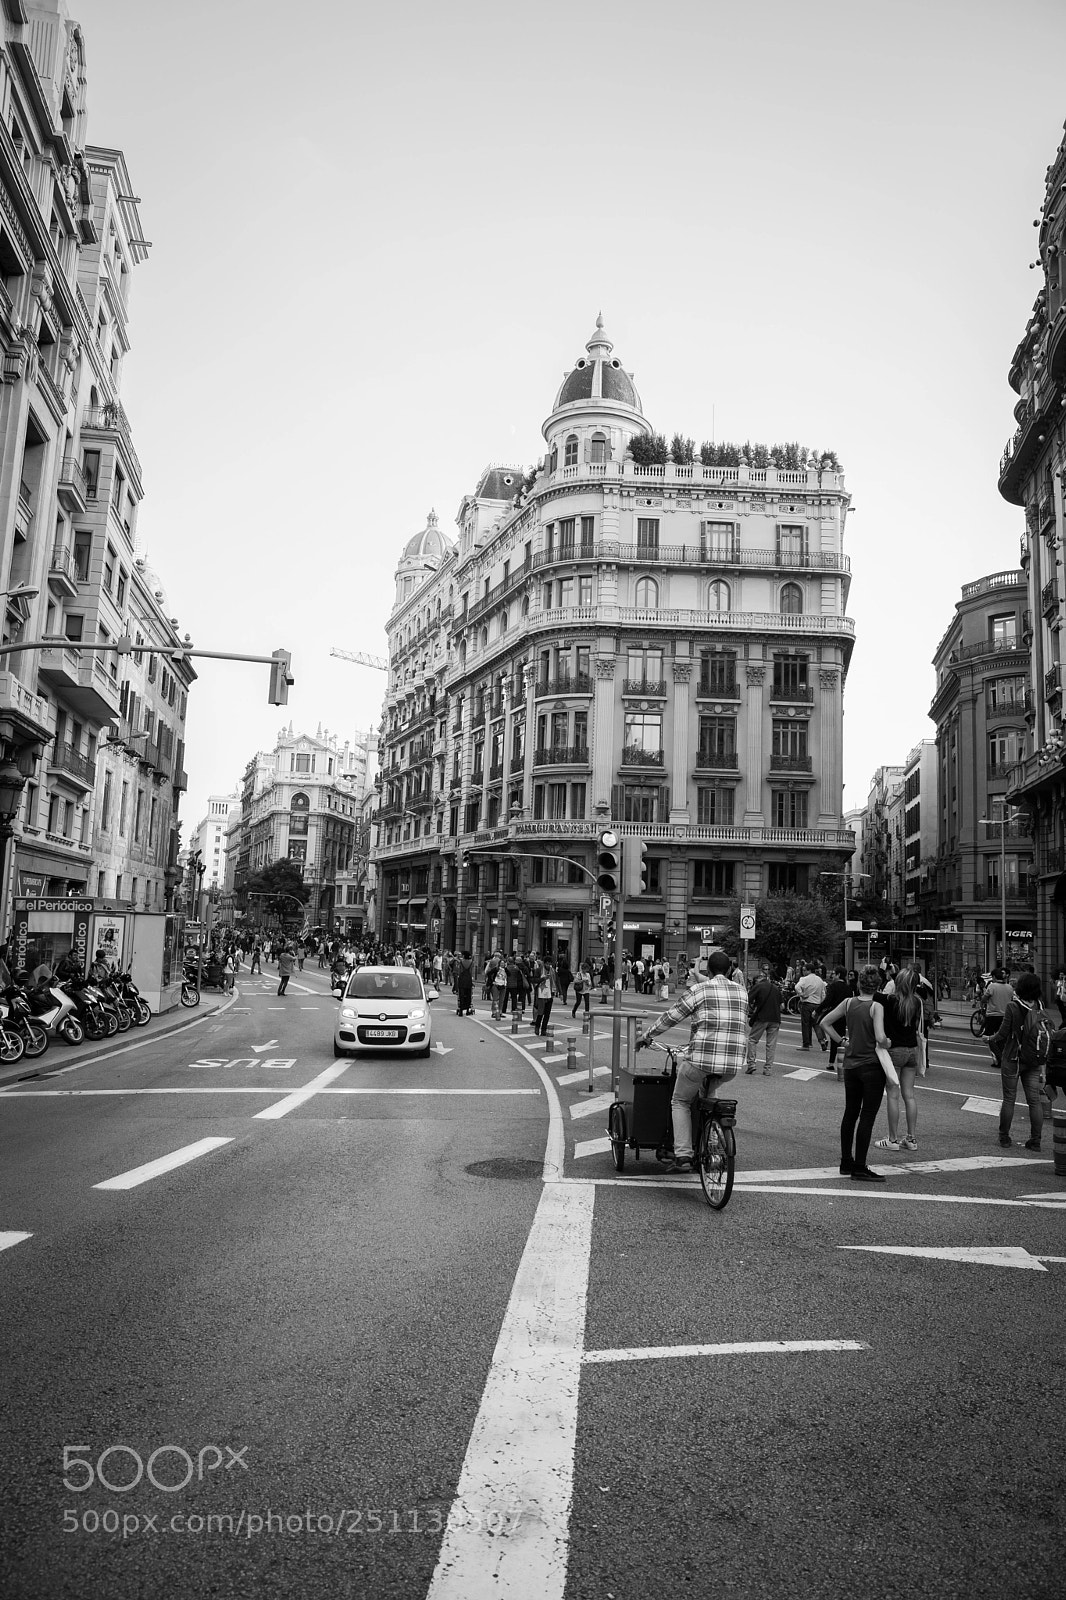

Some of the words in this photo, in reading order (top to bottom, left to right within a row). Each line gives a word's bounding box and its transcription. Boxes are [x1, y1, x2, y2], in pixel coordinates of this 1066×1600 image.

[27, 900, 37, 911] el
[38, 899, 93, 911] Periódico
[602, 898, 611, 910] P
[703, 929, 711, 939] P
[15, 921, 28, 970] eriódico
[188, 1058, 298, 1069] BUS
